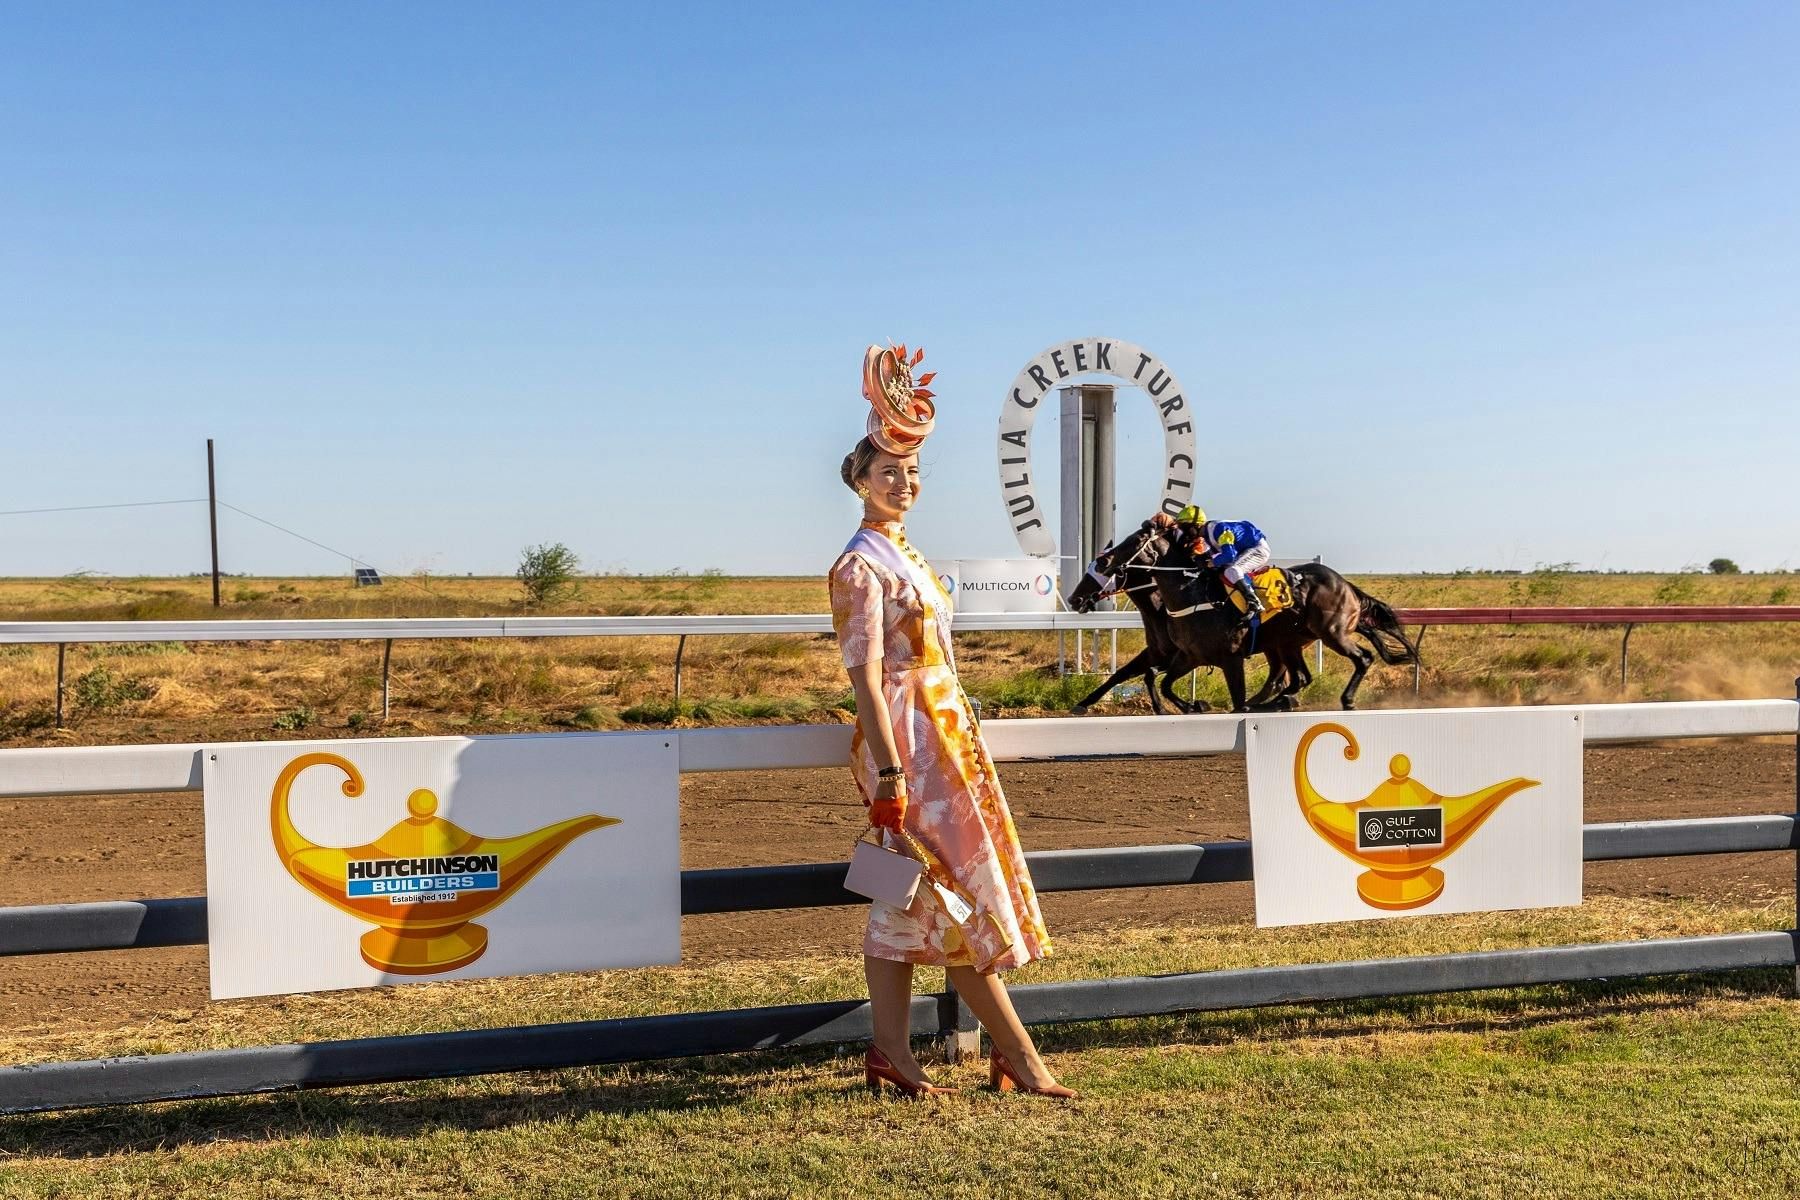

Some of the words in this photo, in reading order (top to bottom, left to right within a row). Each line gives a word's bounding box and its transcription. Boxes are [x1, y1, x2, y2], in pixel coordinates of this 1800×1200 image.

[1013, 342, 1111, 409] CREEK
[1133, 352, 1192, 435] TURF
[1001, 429, 1041, 532] JULIA
[1161, 453, 1193, 518] CLU
[962, 582, 1030, 591] MULTICOM
[1385, 816, 1416, 827] GULF
[1385, 828, 1436, 840] COTTON
[347, 855, 498, 880] HUTCHINSON
[372, 876, 475, 892] BUILDERS
[391, 893, 436, 903] Established
[438, 892, 456, 901] 1912
